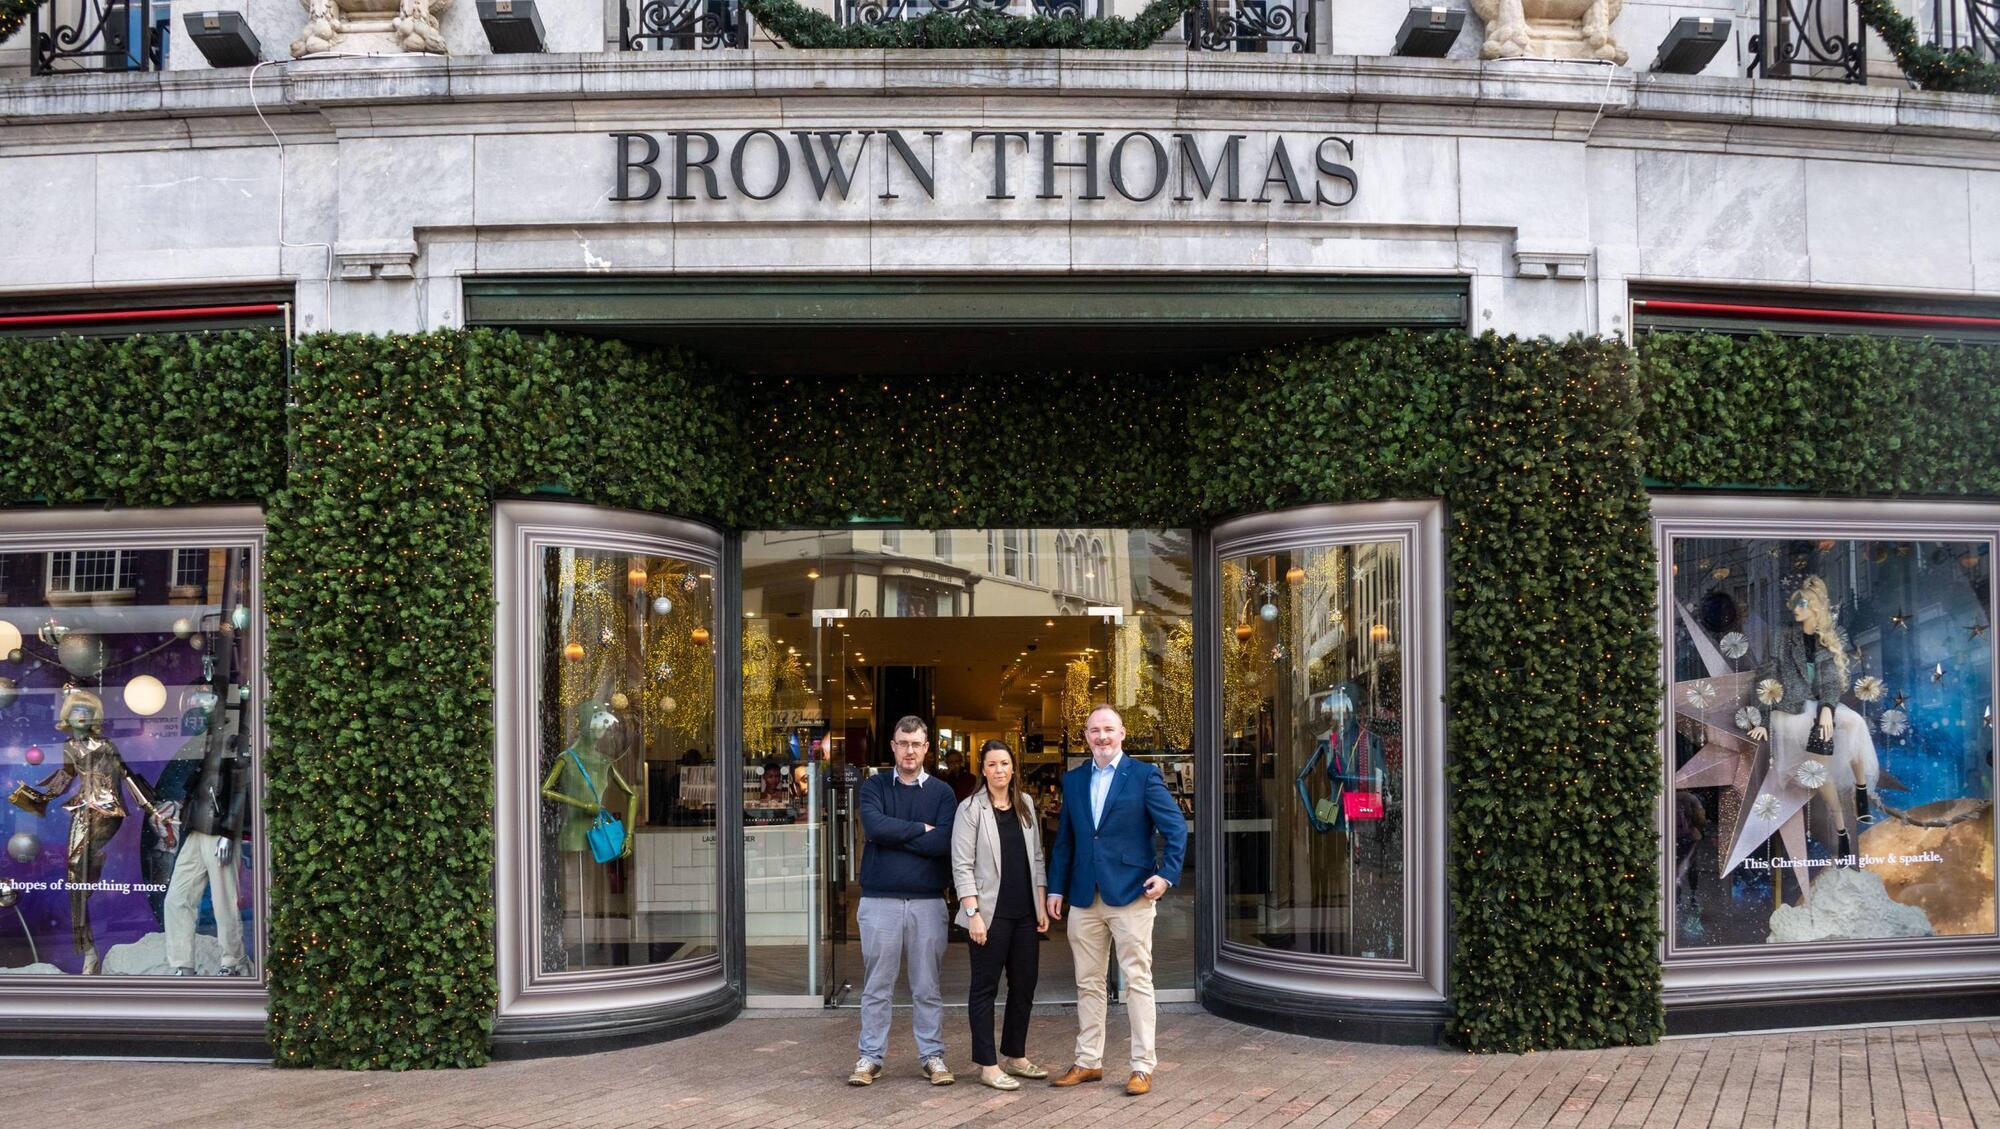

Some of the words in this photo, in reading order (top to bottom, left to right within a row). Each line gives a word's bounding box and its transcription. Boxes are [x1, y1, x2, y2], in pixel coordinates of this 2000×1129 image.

[608, 129, 944, 201] BROWN
[970, 130, 1358, 207] THOMAS
[1743, 858, 1769, 869] This
[1771, 856, 1832, 868] Christmas
[1834, 854, 1856, 866] will
[1858, 853, 1885, 868] glow
[1887, 852, 1896, 864] &
[1899, 851, 1944, 866] sparkle,
[10, 878, 48, 893] hopes
[50, 879, 63, 891] of
[65, 880, 130, 895] something
[133, 883, 167, 892] more
